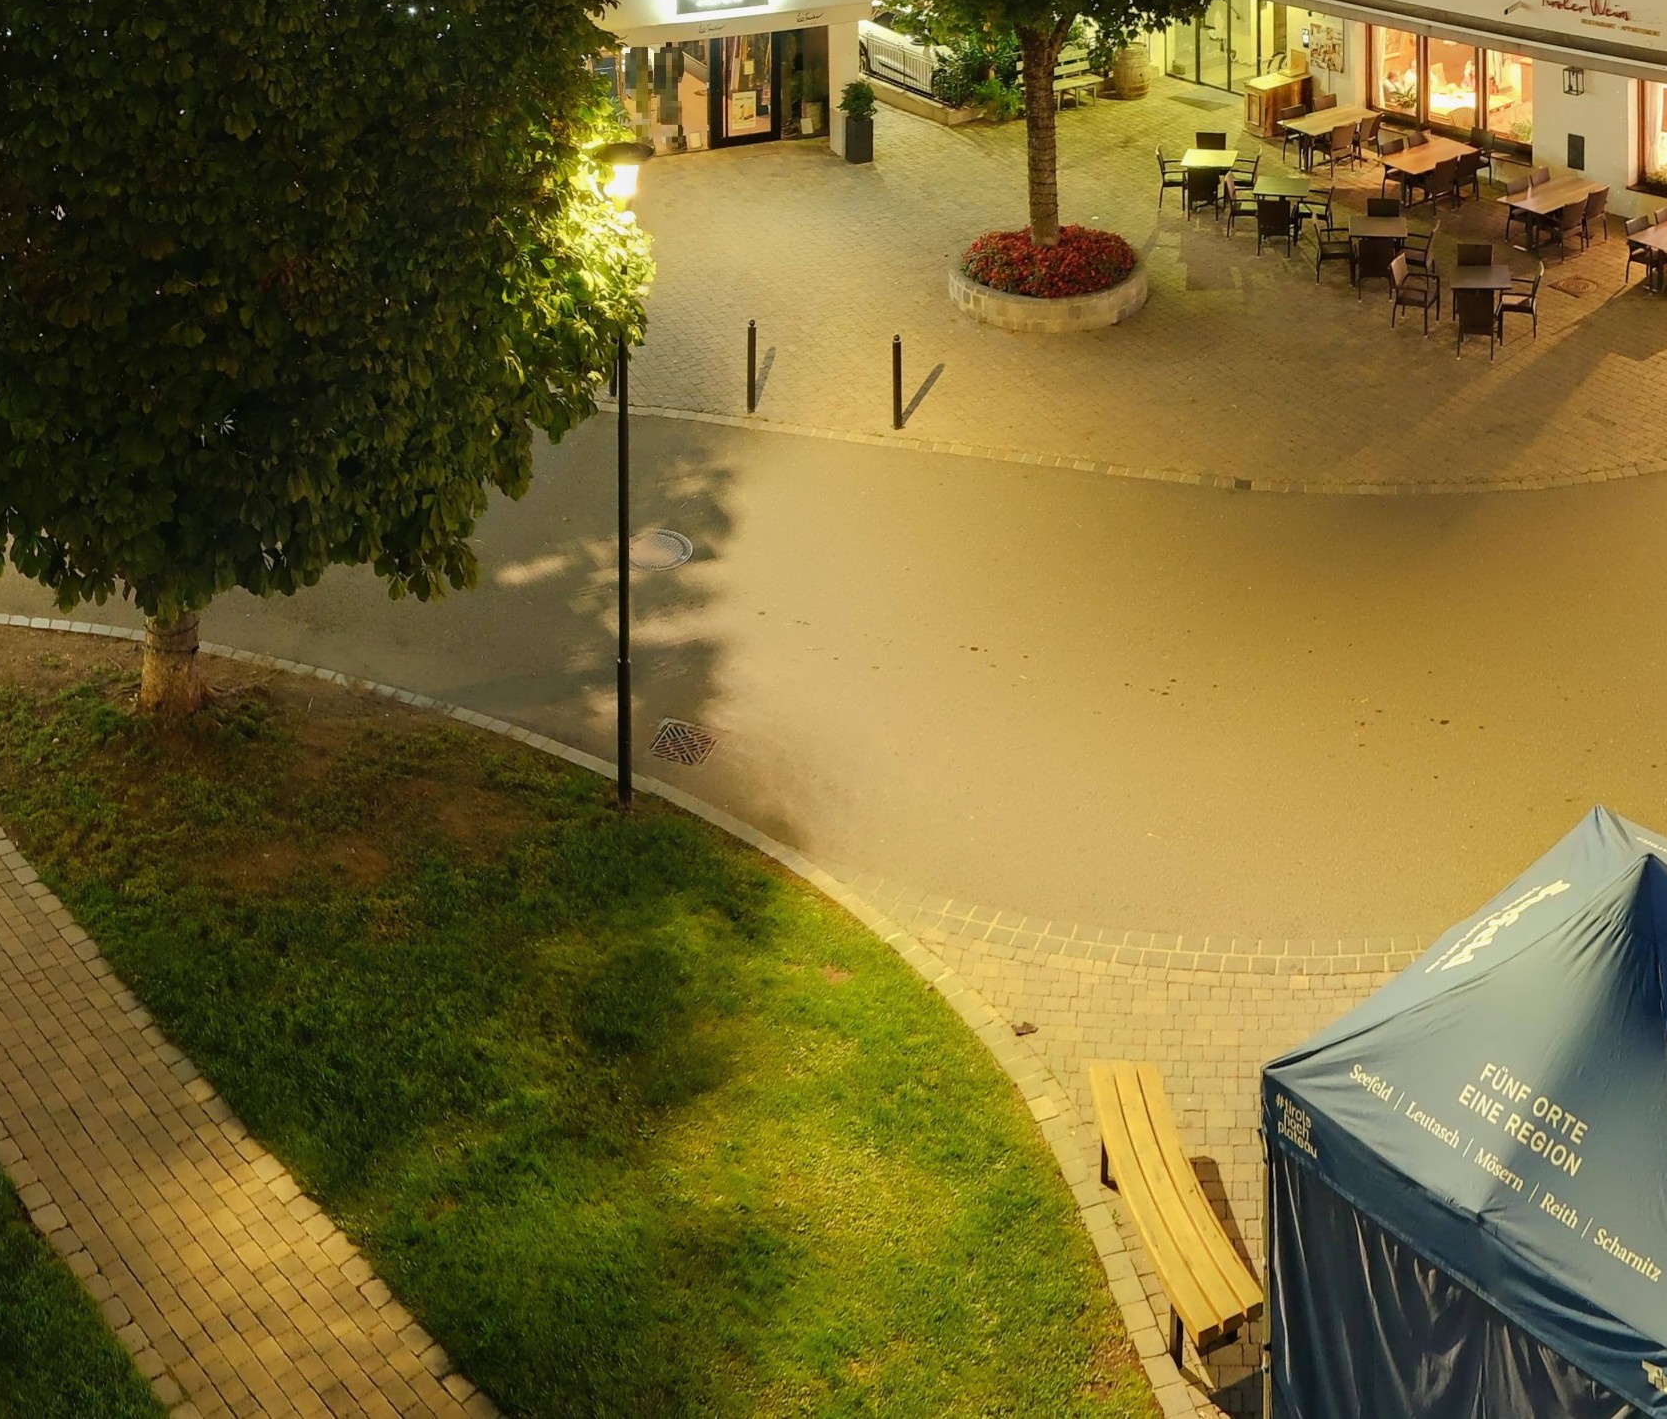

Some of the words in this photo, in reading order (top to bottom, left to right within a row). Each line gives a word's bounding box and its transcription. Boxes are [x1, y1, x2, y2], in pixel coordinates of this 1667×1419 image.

[1275, 1093, 1312, 1128] #tirols
[1284, 1110, 1310, 1141] hoch
[1459, 1084, 1506, 1124] EINE
[1503, 1115, 1583, 1177] REGION
[1479, 1062, 1531, 1104] FÜNF
[1532, 1096, 1588, 1146] ORTE
[1277, 1120, 1318, 1159] plateau
[1350, 1064, 1393, 1103] Seefeld
[1405, 1100, 1462, 1150] Leutasch
[1473, 1147, 1524, 1193] Mösern
[1539, 1191, 1578, 1229] Reith
[1593, 1228, 1663, 1282] Scharnitz
